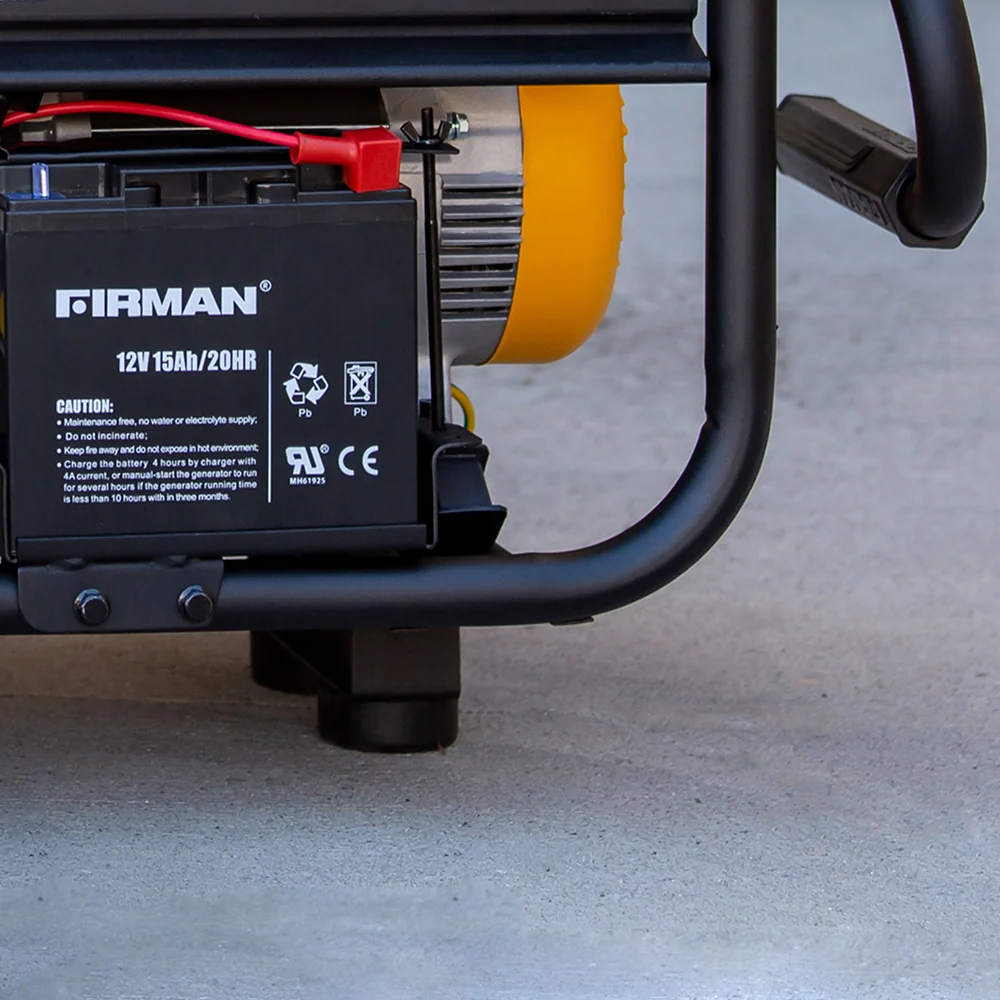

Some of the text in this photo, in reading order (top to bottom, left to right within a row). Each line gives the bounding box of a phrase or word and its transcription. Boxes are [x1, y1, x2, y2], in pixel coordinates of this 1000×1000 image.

[116, 349, 257, 373] 12V 15Ah/20HR
[56, 398, 114, 414] CAUTION:
[298, 408, 312, 418] Pb
[353, 407, 368, 417] Pb
[64, 417, 117, 427] Maintenance
[118, 417, 137, 426] free,
[150, 416, 174, 425] water
[175, 417, 184, 425] or
[185, 416, 227, 426] electrolyte
[65, 431, 148, 440] Do not incinerate;
[64, 446, 85, 456] Keep
[85, 446, 98, 454] fire
[98, 446, 119, 456] away
[120, 445, 135, 454] and
[136, 445, 146, 453] do
[147, 445, 160, 453] not
[160, 445, 188, 455] expose
[189, 444, 196, 452] in
[197, 444, 210, 452] hot
[64, 457, 257, 470] Charge the battery 4 hours by charger with
[338, 445, 379, 476] CE
[63, 472, 76, 480] 4A
[76, 471, 110, 480] current,
[111, 472, 121, 480] or
[122, 470, 175, 479] manual-start
[176, 470, 190, 478] the
[191, 470, 232, 480] generator
[233, 469, 242, 478] to
[63, 480, 257, 492] for several hours if the generator running time
[289, 477, 326, 485] MH61925
[63, 492, 231, 503] is less than 10 hours with in three months.
